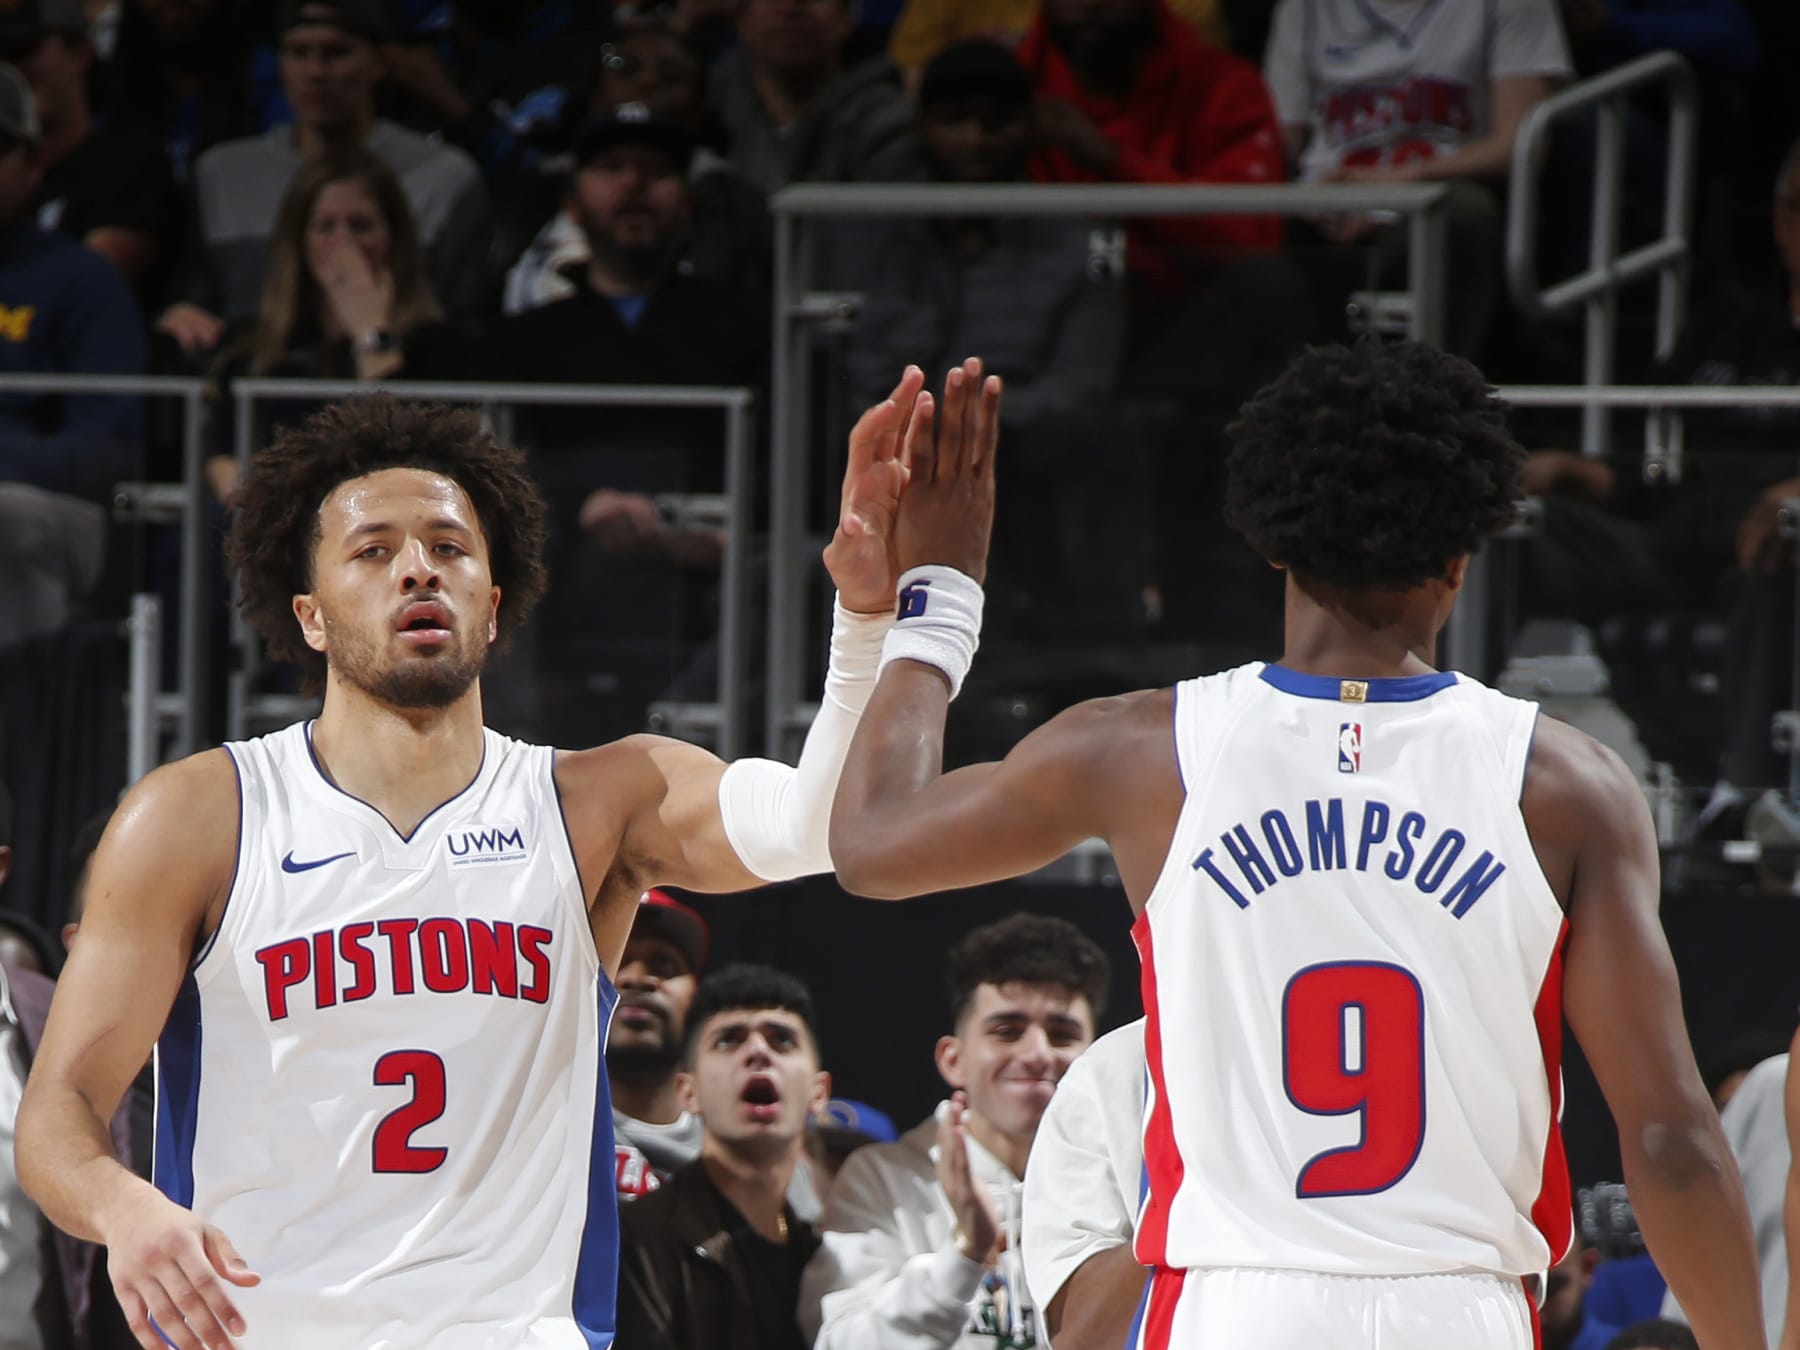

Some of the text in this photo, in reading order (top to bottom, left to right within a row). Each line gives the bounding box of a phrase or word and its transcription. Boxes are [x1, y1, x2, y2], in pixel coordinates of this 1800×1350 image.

[447, 826, 525, 856] UWM
[1191, 797, 1507, 921] THOMPSON
[255, 917, 553, 1021] PISTONS
[372, 1048, 449, 1174] 2
[1281, 959, 1427, 1200] 9
